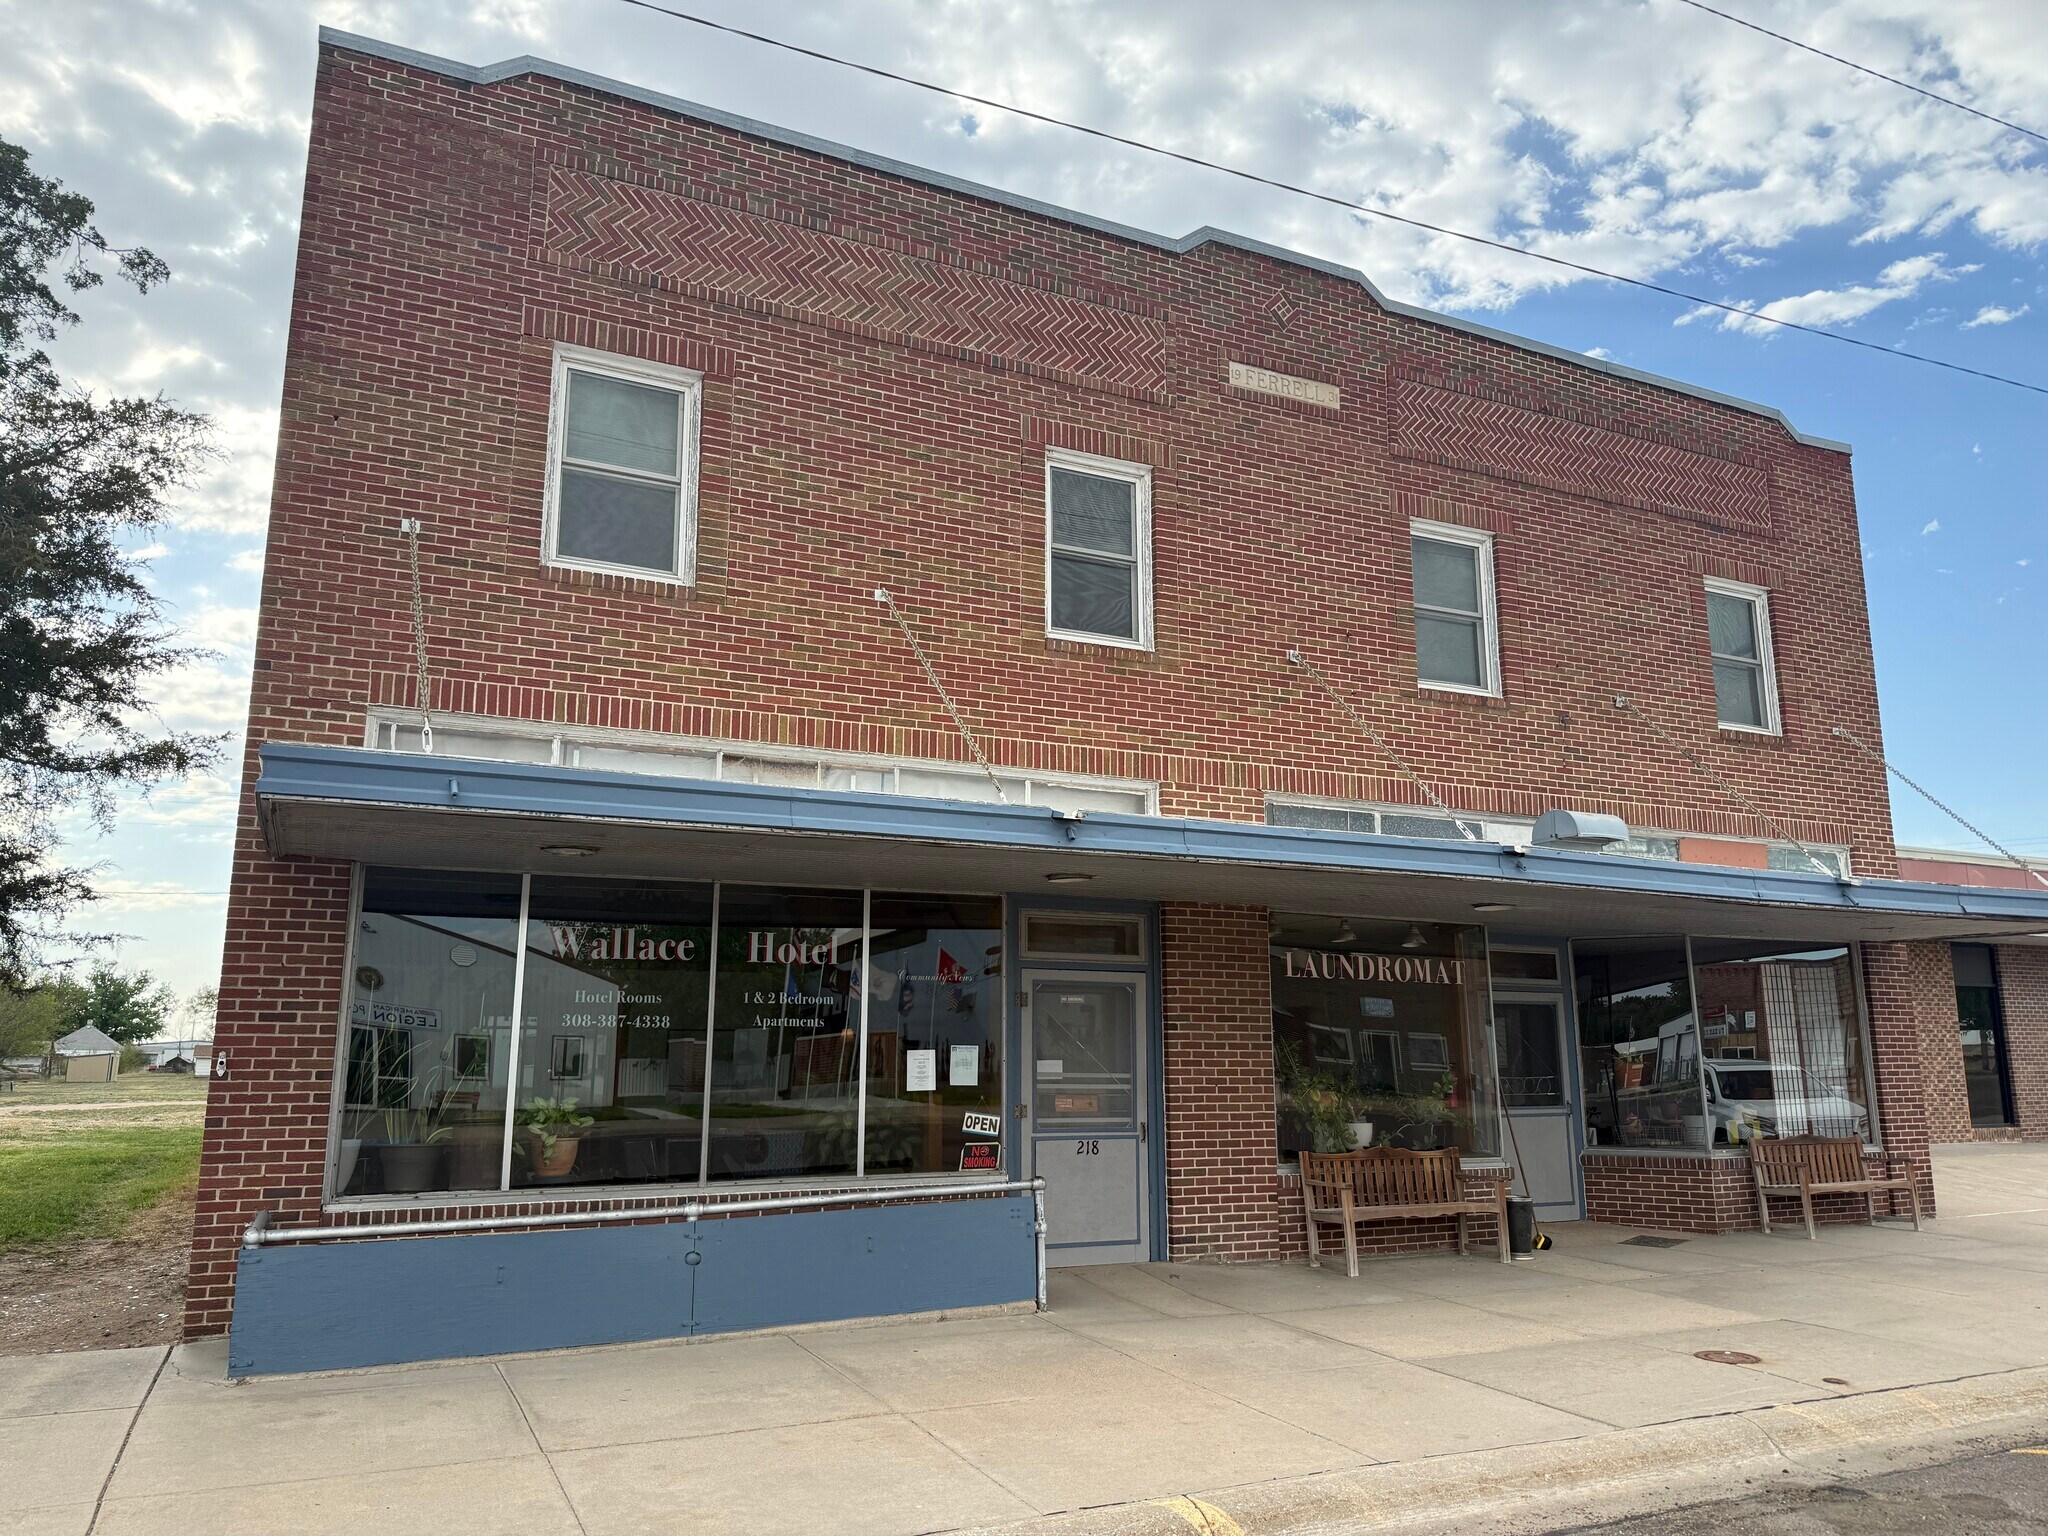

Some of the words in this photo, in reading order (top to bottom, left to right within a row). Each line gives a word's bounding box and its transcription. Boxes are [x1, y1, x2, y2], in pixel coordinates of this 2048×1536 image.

[1230, 368, 1241, 380] 19
[1245, 369, 1325, 403] FERRELL
[552, 926, 695, 961] Wallace
[747, 931, 839, 965] Hotel
[1284, 951, 1466, 985] LAUNDROMAT
[898, 969, 947, 985] Community
[948, 970, 973, 983] News
[574, 990, 613, 1004] Hotel
[617, 991, 662, 1004] Rooms
[743, 992, 750, 1004] 1
[754, 992, 766, 1004] &
[768, 992, 776, 1004] 2
[779, 992, 834, 1006] Bedroom
[561, 1013, 671, 1029] 308-387-4338
[753, 1014, 825, 1030] Apartments
[965, 1115, 998, 1133] OPEN
[971, 1146, 990, 1157] NO
[1076, 1140, 1100, 1156] 218
[963, 1156, 996, 1168] SMOKING
